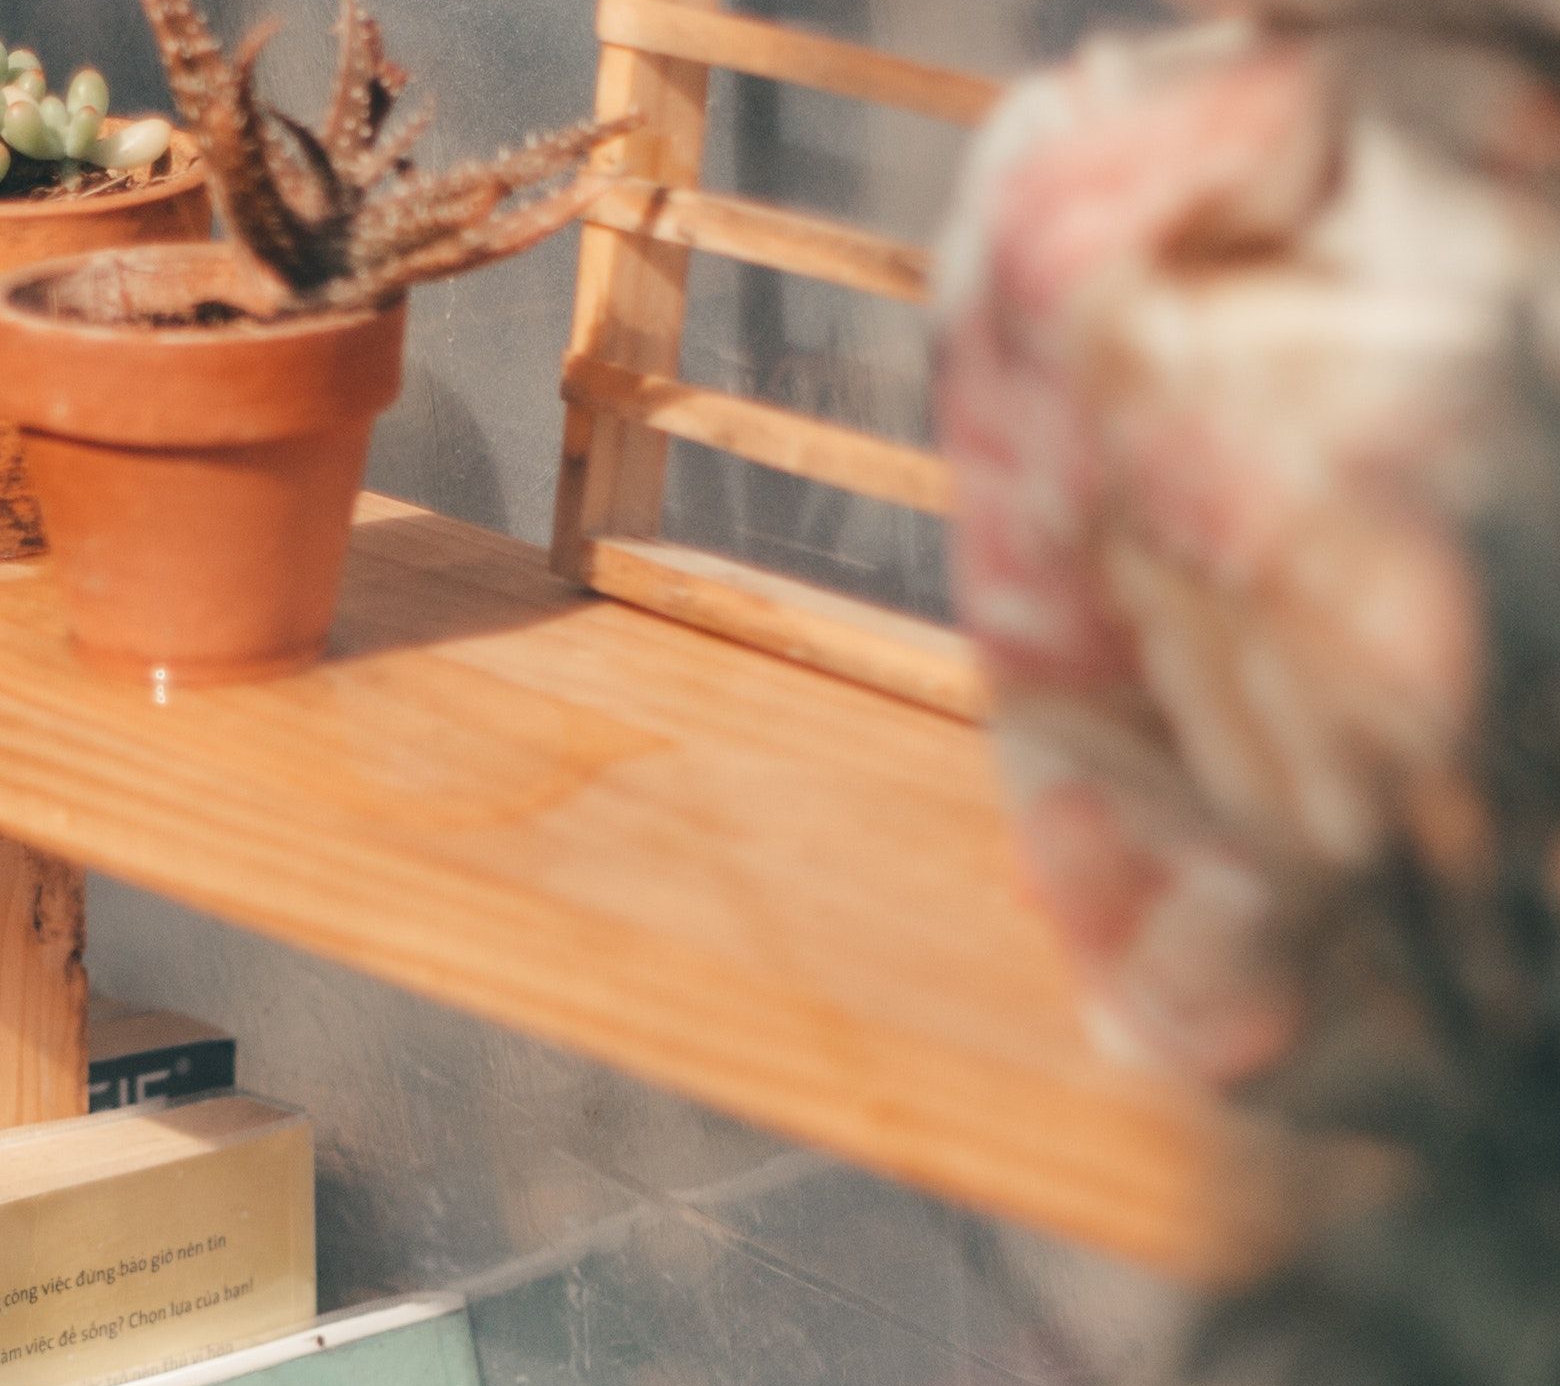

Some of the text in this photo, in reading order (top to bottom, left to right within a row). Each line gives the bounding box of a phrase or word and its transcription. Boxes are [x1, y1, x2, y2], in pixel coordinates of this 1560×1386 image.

[4, 1285, 38, 1308] công
[41, 1273, 72, 1296] việc
[178, 1241, 204, 1259] nên
[207, 1234, 227, 1252] tin
[25, 1335, 55, 1356] việc
[58, 1324, 77, 1346] để
[128, 1307, 167, 1330] Chọn
